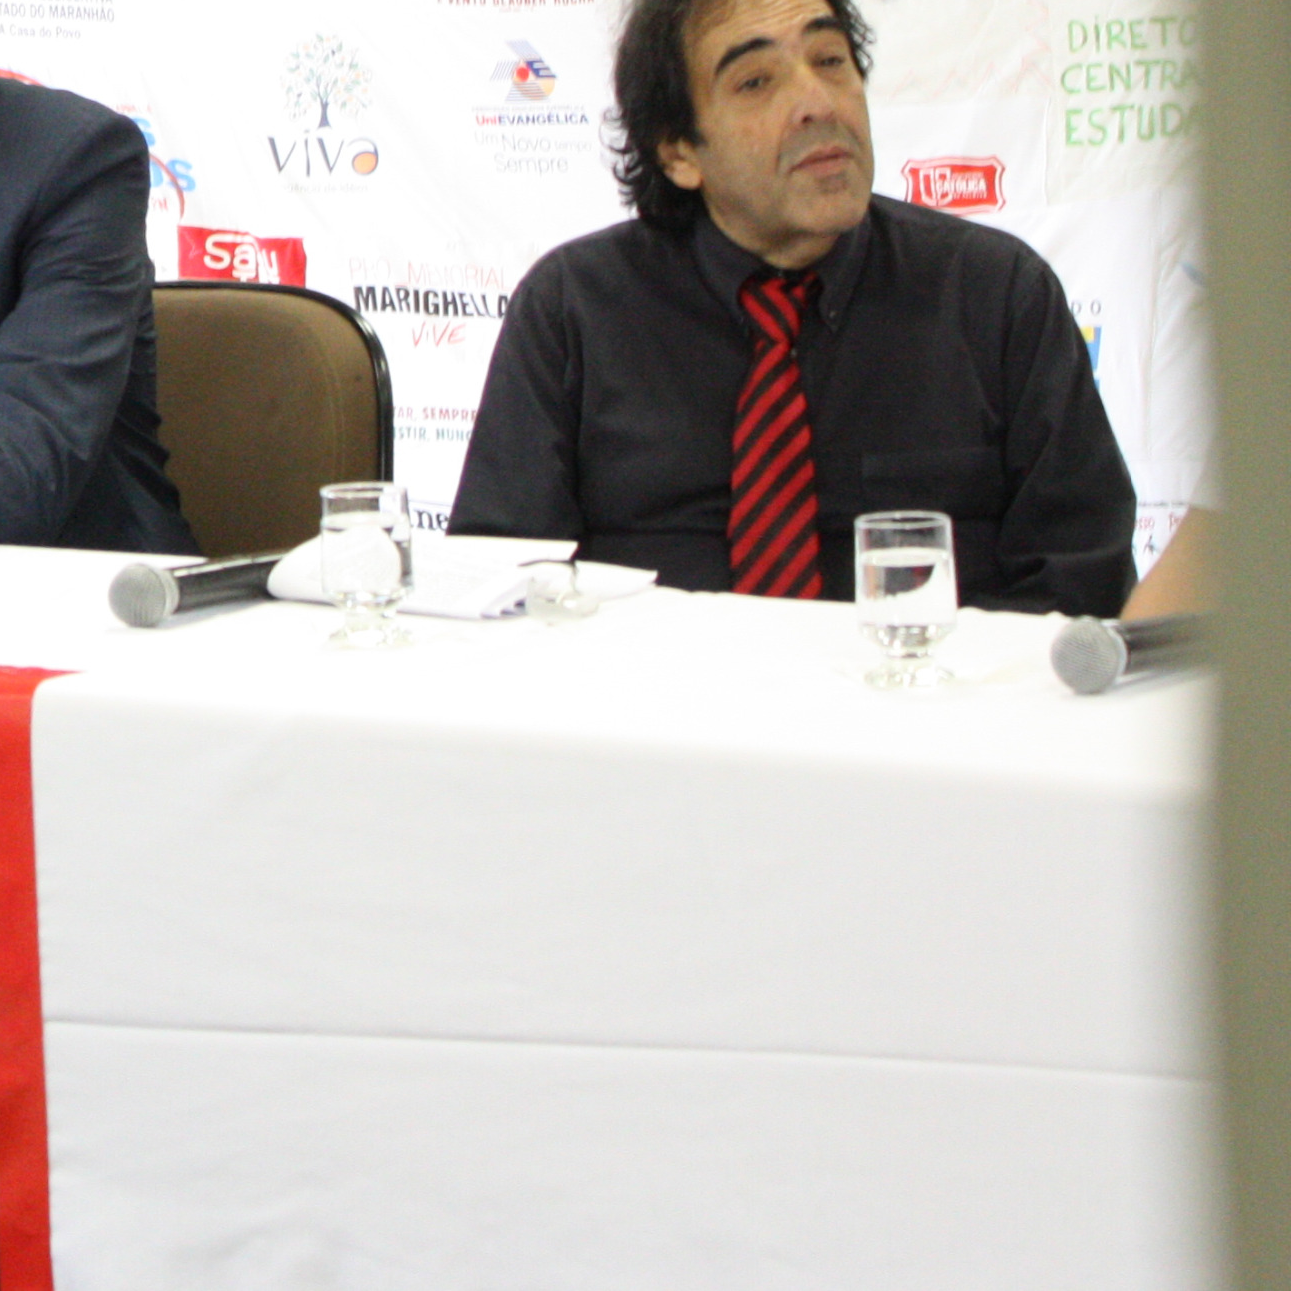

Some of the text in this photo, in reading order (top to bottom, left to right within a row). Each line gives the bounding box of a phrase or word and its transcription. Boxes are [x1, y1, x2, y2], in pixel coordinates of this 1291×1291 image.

[30, 4, 45, 19] DO
[49, 4, 115, 23] MARANHÃO
[10, 24, 35, 38] Casa
[40, 26, 52, 38] do
[56, 27, 81, 39] Povo
[494, 152, 568, 177] Sempre
